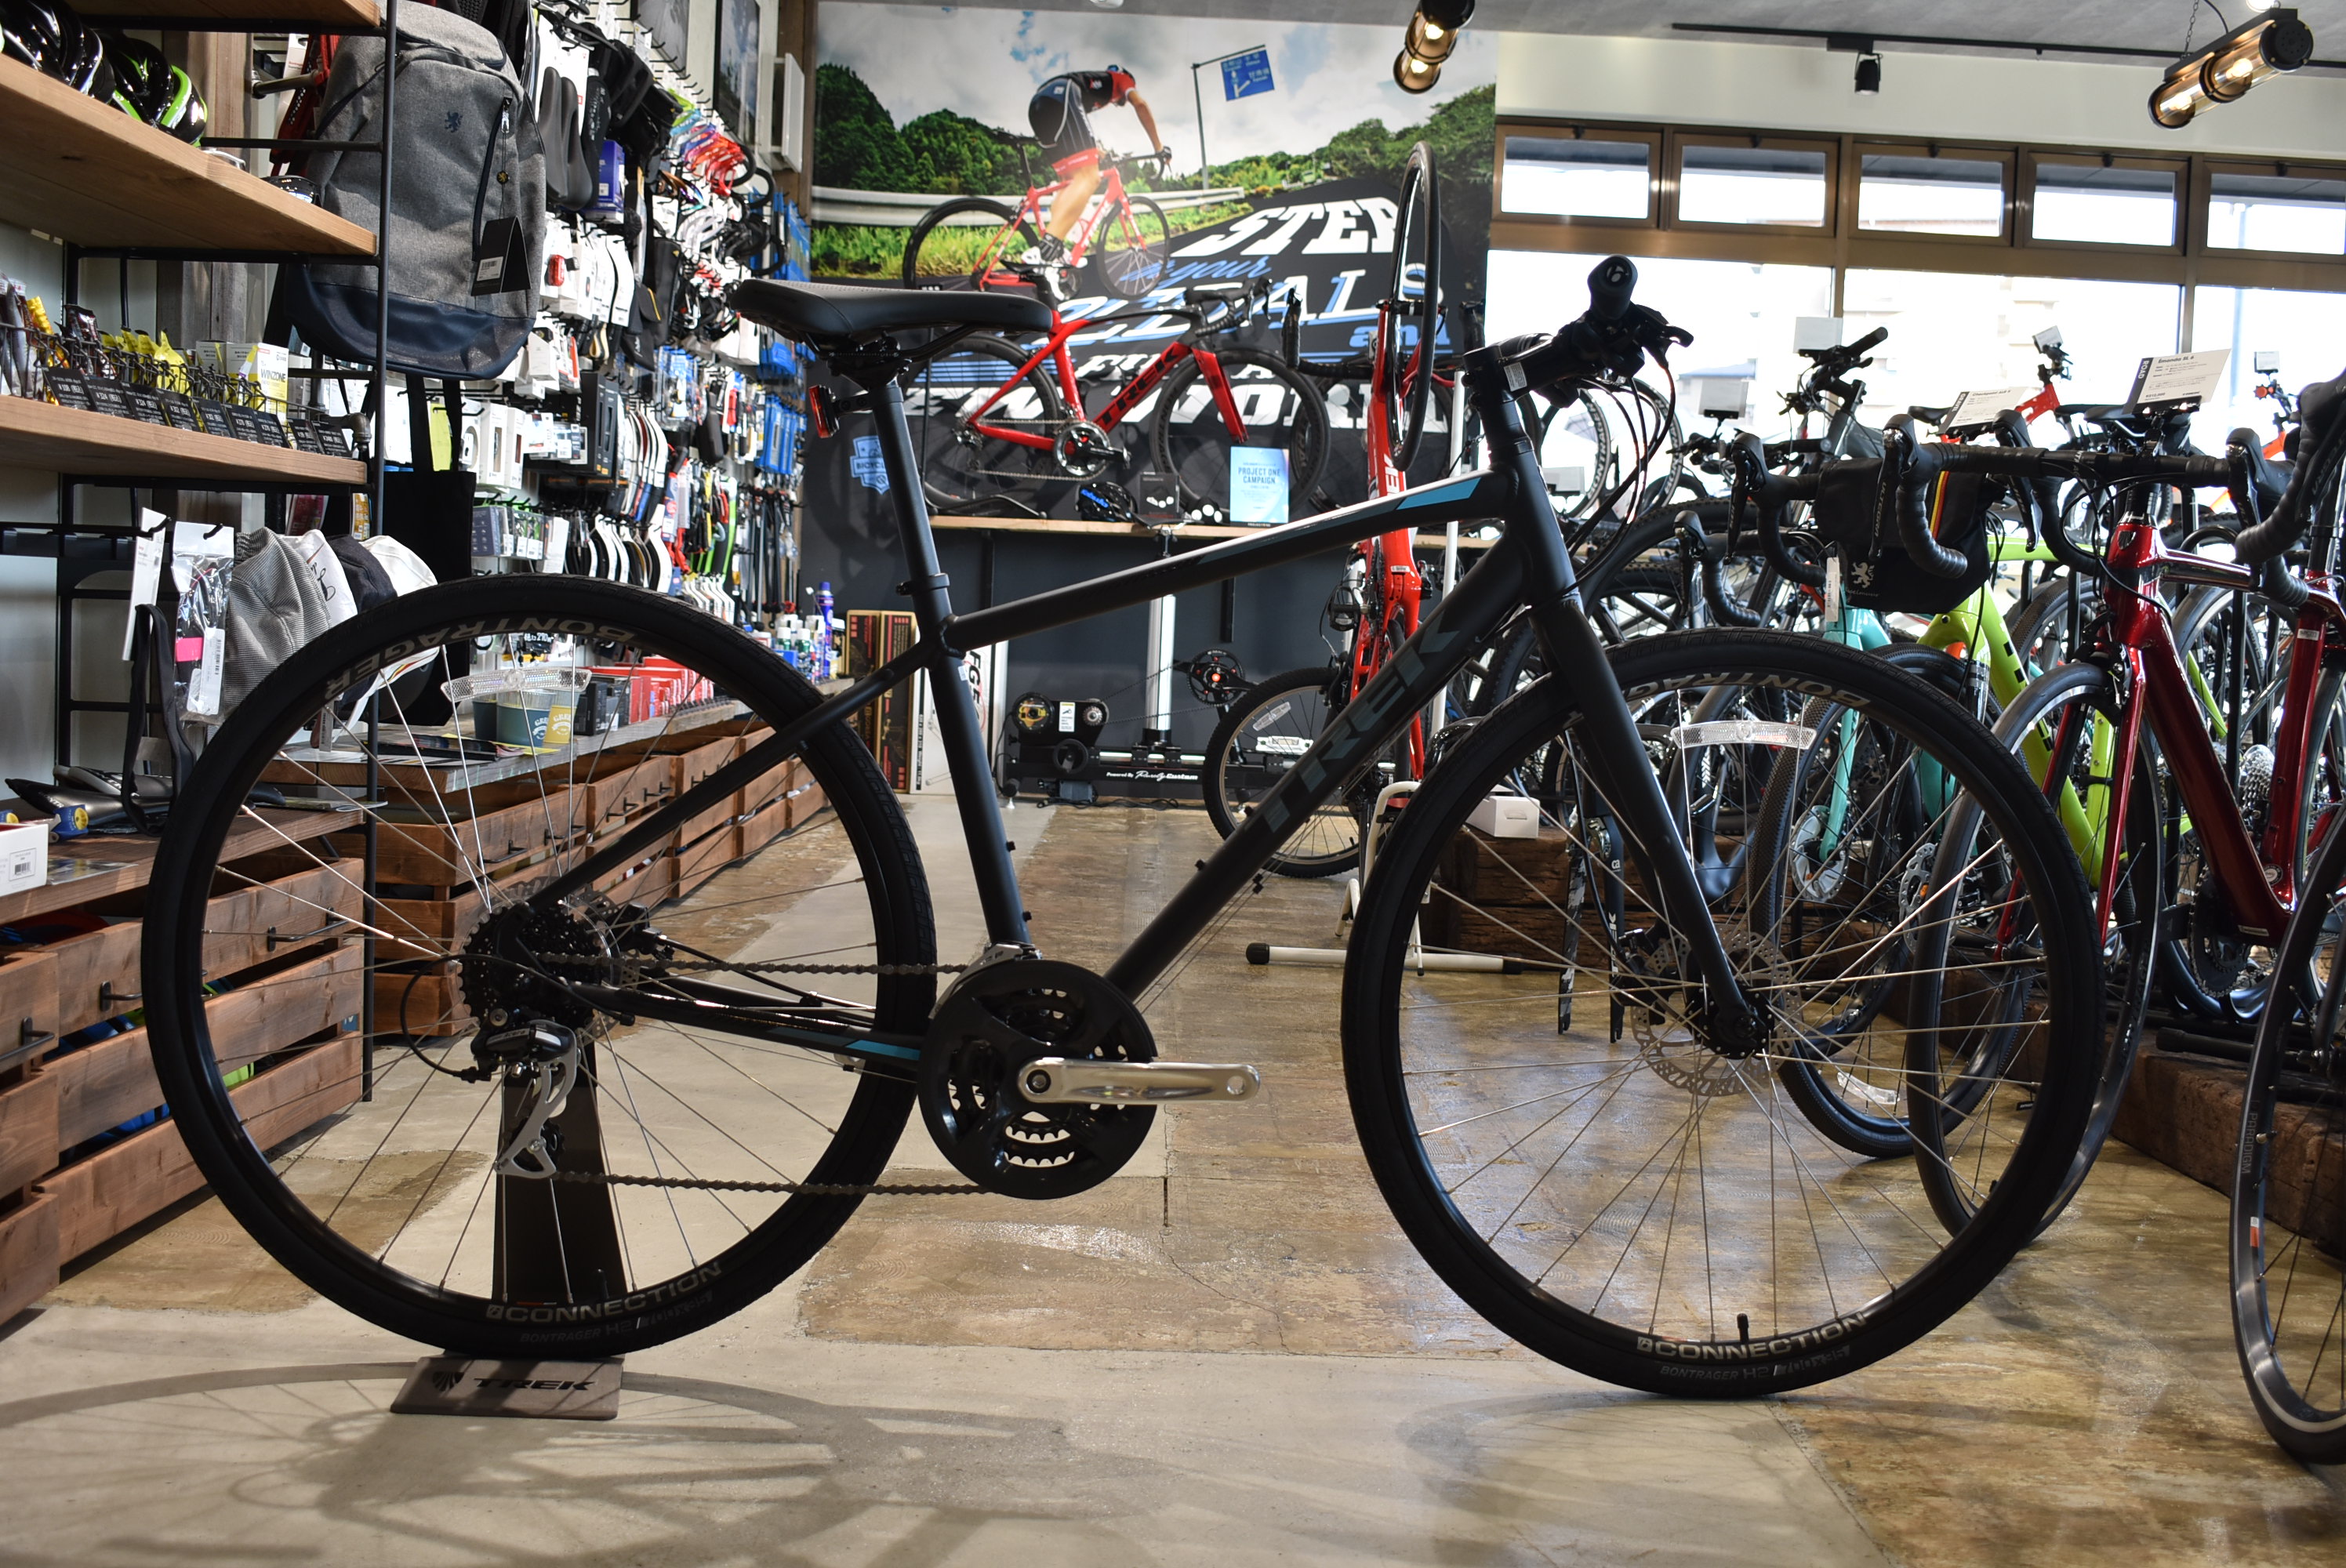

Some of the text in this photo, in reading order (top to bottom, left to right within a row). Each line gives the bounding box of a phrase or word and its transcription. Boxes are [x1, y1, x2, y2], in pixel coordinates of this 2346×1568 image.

[1157, 256, 1272, 289] your
[261, 369, 286, 383] WINZONE
[1095, 350, 1178, 426] TREK
[1237, 467, 1266, 476] PROJECT
[324, 616, 636, 700] BONTRAGER
[1247, 612, 1462, 833] TREK
[2242, 1112, 2258, 1174] PARADIGM
[506, 1261, 723, 1323] CONNECTION
[520, 1327, 601, 1344] BONTRAGER
[605, 1320, 631, 1336] H2
[1655, 1311, 1868, 1360] CONNECTION
[474, 1377, 599, 1392] TREK
[1660, 1365, 1740, 1381] BONTRAGER
[1744, 1366, 1770, 1379] H2
